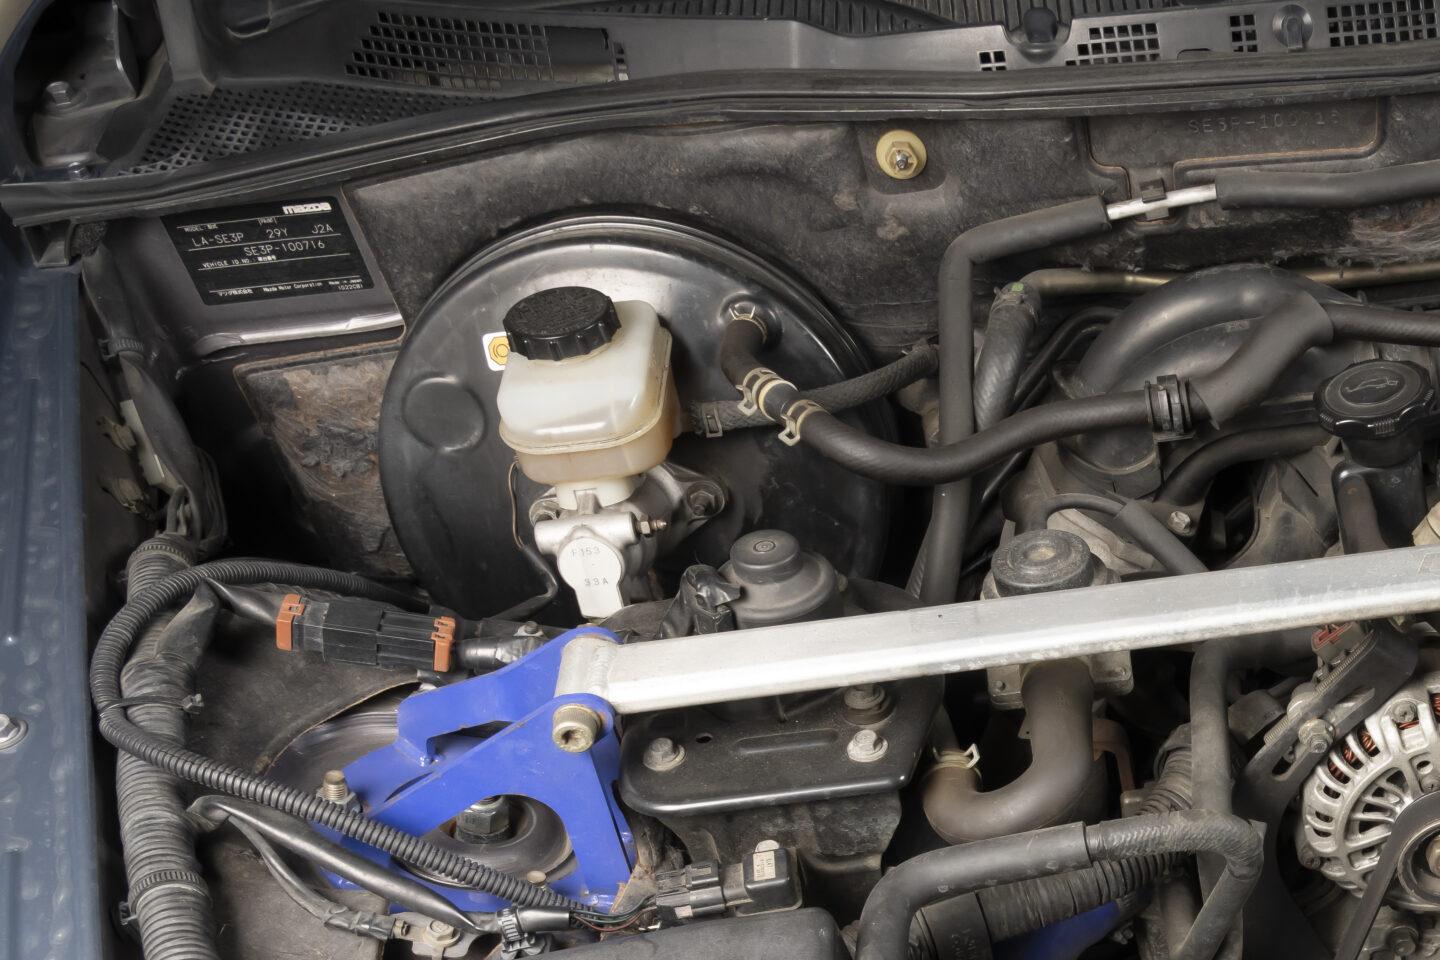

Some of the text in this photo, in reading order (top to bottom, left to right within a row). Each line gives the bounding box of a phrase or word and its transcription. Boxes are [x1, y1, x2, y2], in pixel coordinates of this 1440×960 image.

[265, 227, 289, 240] 29Y
[311, 223, 334, 235] J2A
[192, 231, 244, 247] LA-SE3P
[243, 239, 326, 256] SE3P-100716
